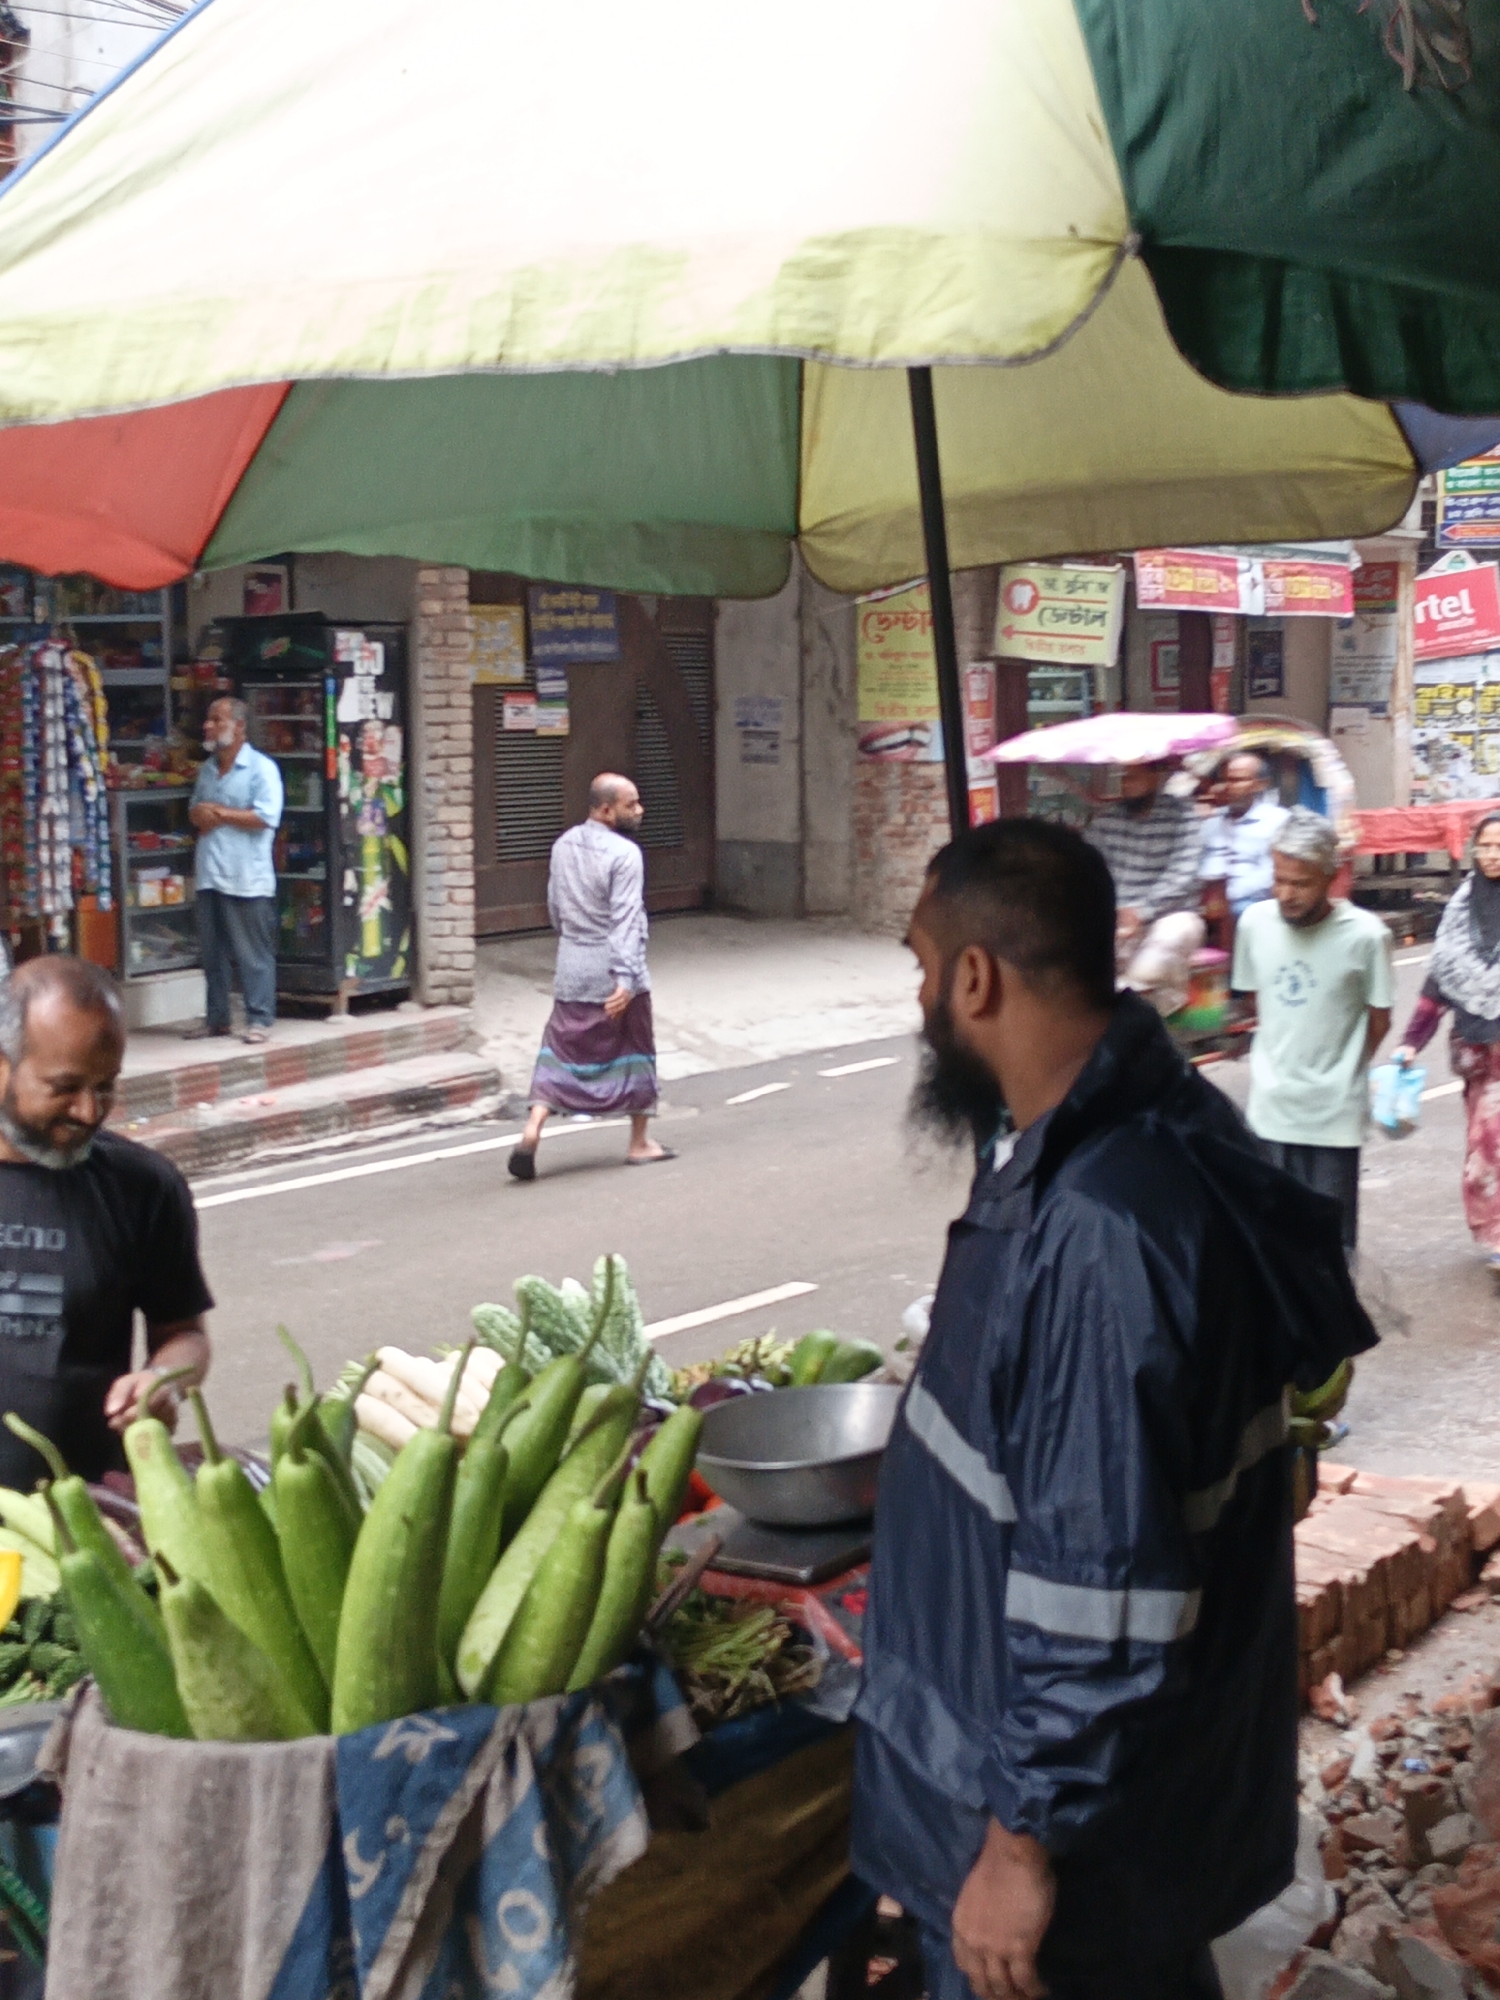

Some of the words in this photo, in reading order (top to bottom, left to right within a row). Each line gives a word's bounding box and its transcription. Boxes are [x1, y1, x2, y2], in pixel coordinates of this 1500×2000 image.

[1037, 605, 1107, 627] ডেন্টাল
[1414, 588, 1476, 624] rtel
[862, 601, 934, 644] ডেন্টা
[0, 1224, 66, 1250] ECNO
